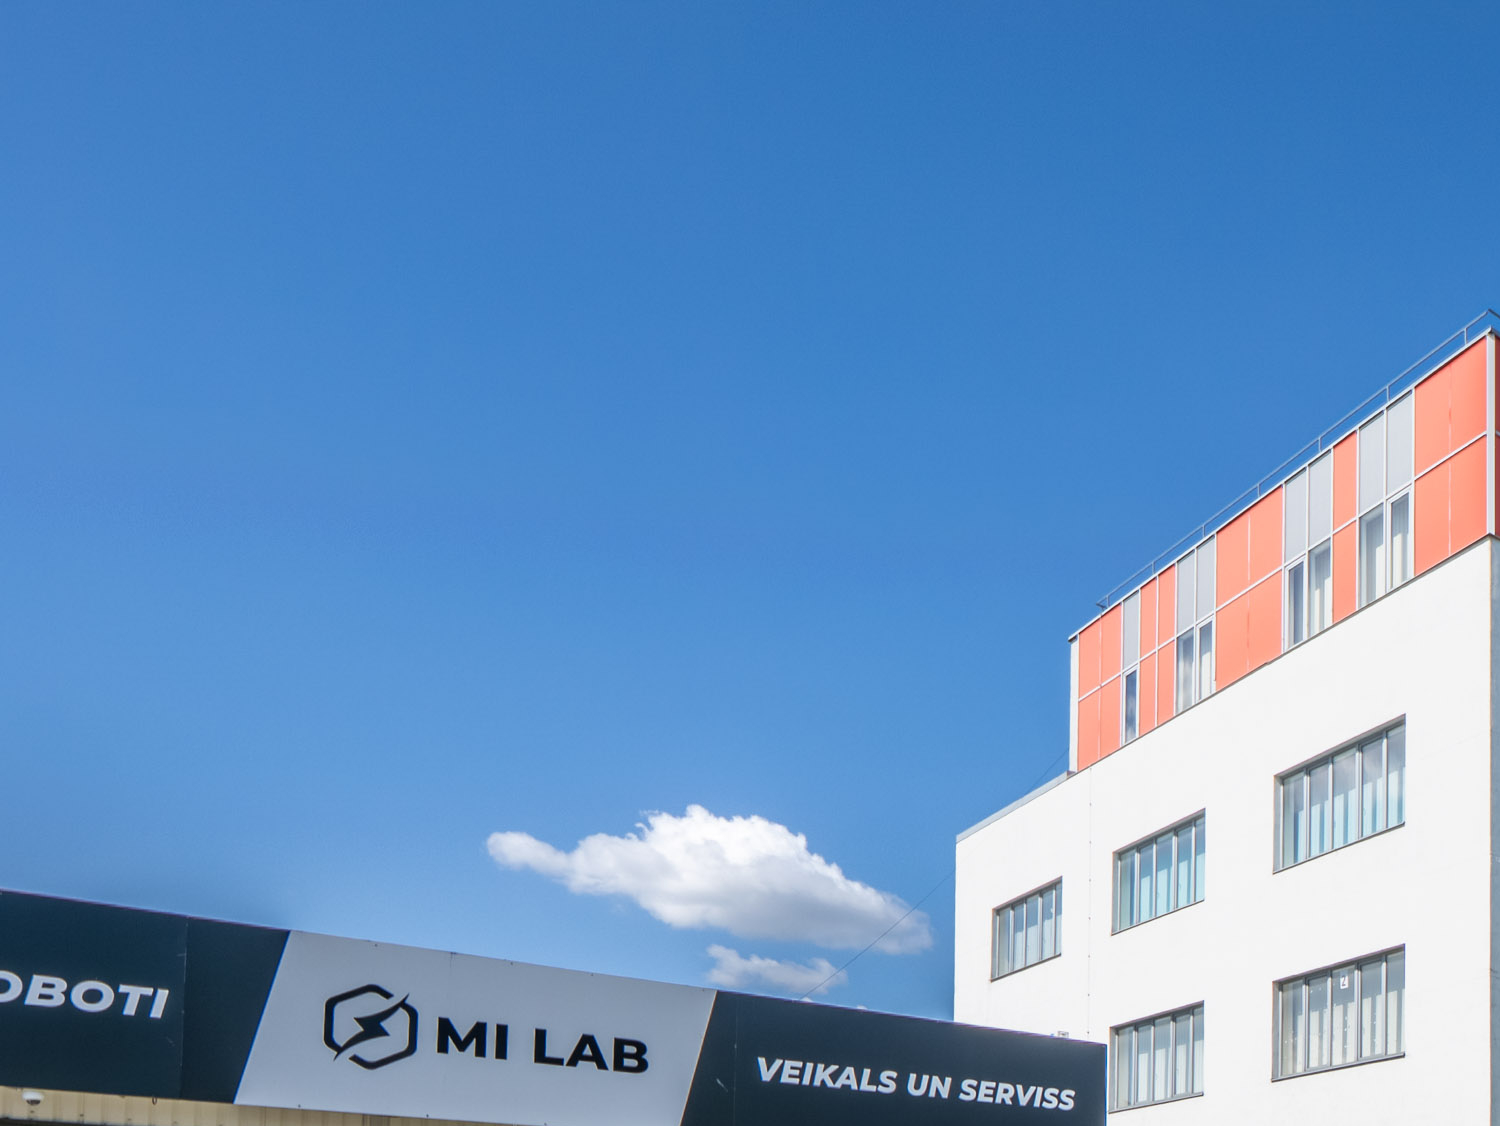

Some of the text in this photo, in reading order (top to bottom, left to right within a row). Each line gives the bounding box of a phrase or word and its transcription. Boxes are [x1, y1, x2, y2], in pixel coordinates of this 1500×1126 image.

[436, 1016, 649, 1074] MI LAB
[757, 1056, 1076, 1111] VEIKALS UN SERVISS
